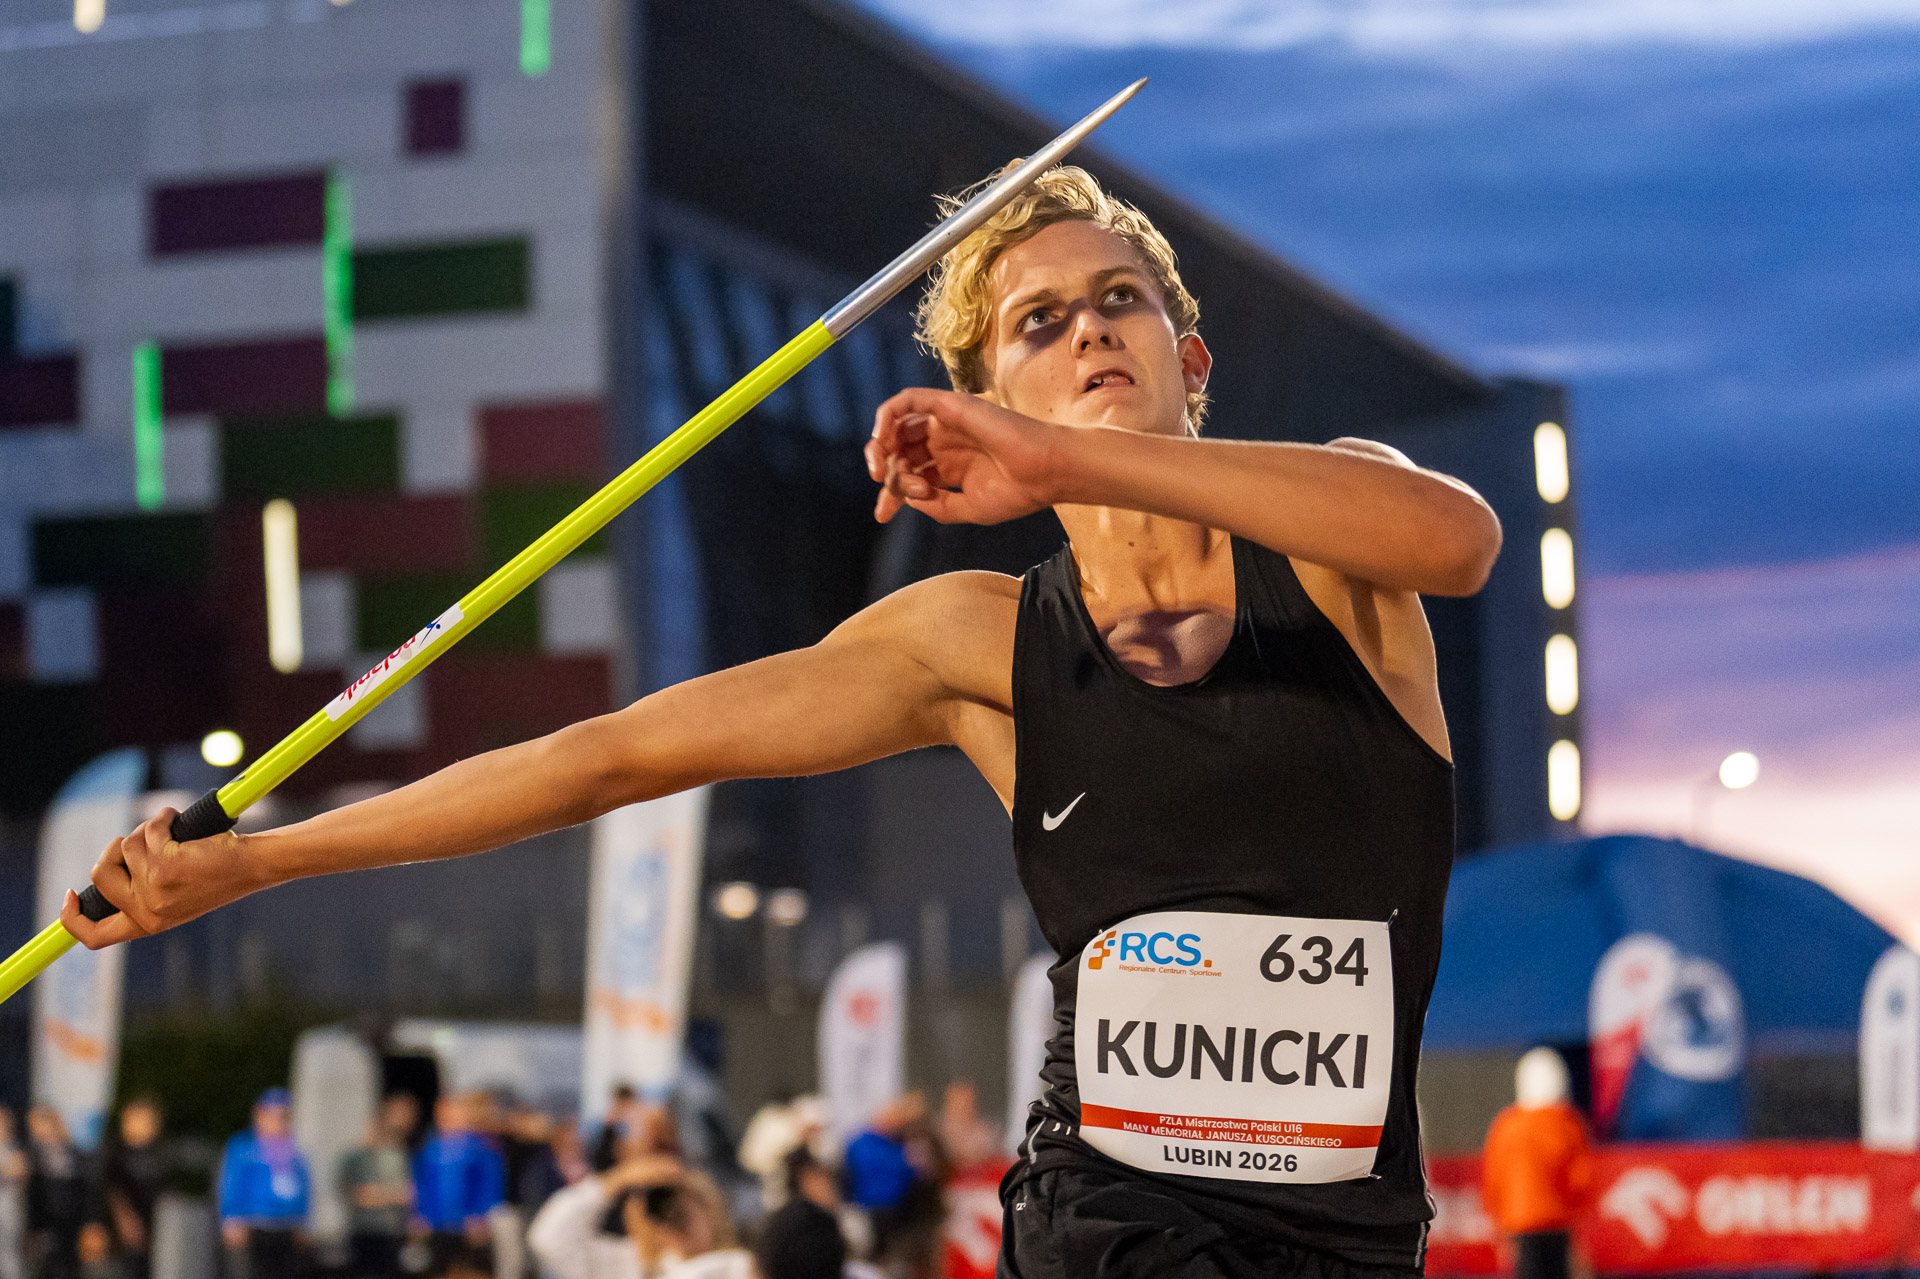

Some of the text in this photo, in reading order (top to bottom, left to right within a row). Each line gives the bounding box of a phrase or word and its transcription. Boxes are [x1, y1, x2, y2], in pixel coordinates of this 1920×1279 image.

[1119, 964, 1222, 977] Regionalne Centrum Sportowe
[1260, 934, 1368, 986] 634
[1097, 1018, 1369, 1089] KUNICKI
[1123, 1121, 1342, 1147] MAŁY MEMORIAŁ JANUSZA KUSOCIŃSKIEGO
[1159, 1115, 1303, 1134] PZLA Mistrzostwa Polski U16
[1163, 1145, 1298, 1172] LUBIN 2026
